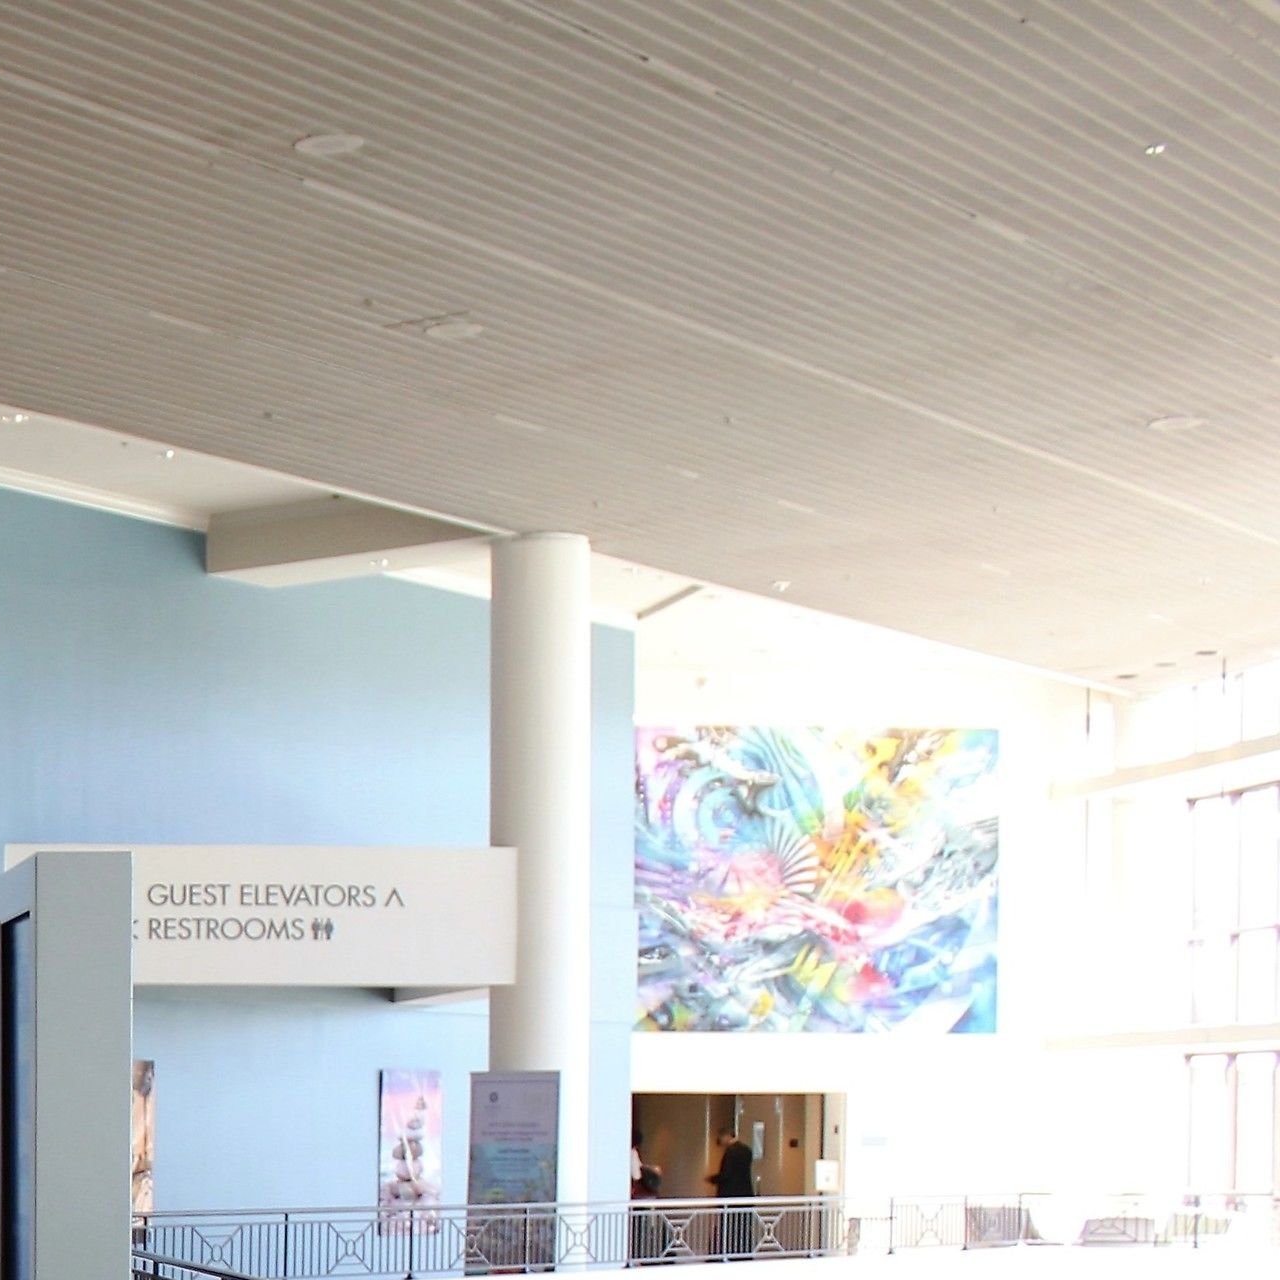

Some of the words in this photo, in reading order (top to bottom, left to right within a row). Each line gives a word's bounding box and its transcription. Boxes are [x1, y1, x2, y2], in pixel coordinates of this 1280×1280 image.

[147, 883, 231, 907] GUEST
[239, 884, 377, 908] ELEVATORS
[148, 917, 305, 941] RESTROOMS
